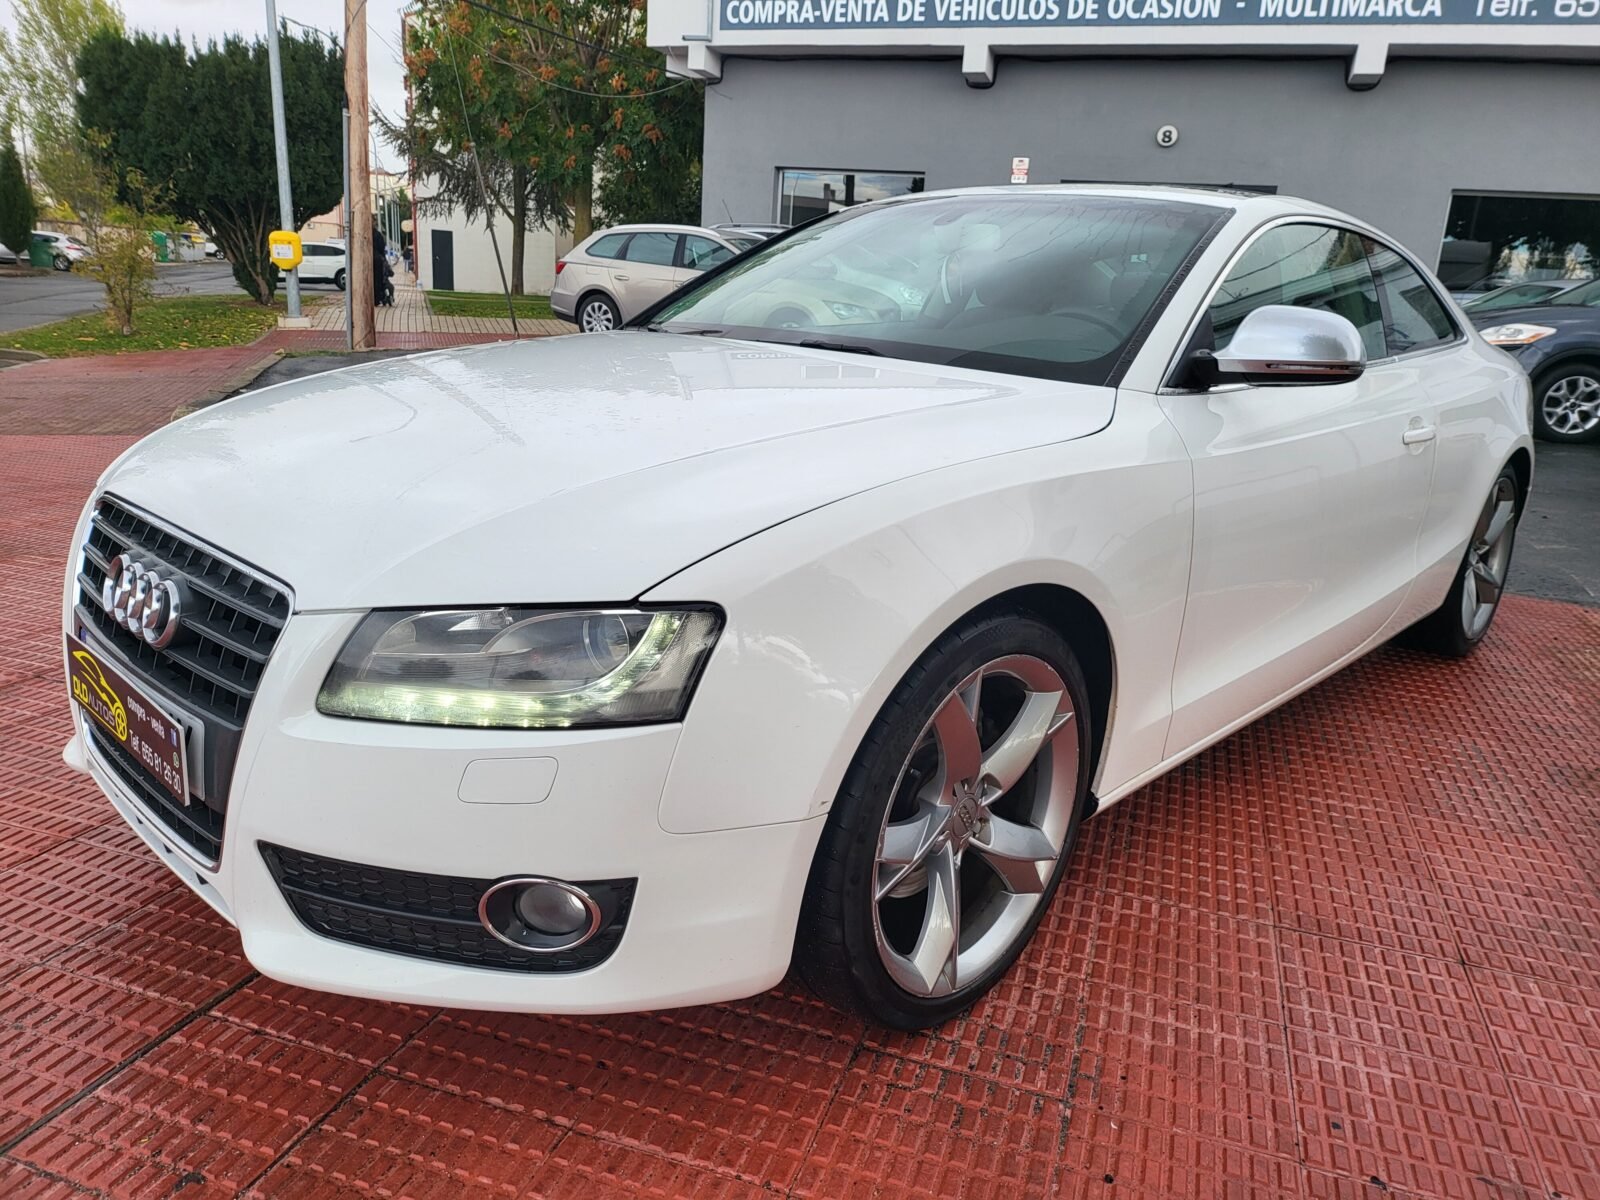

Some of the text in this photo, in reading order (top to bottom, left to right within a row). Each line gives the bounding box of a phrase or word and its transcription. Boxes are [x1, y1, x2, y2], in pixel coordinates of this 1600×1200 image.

[726, 0, 889, 24] COMPRA-VENTA
[897, 0, 926, 22] DE
[1067, 0, 1099, 20] DE
[1259, 0, 1443, 18] MULTIMARCA
[1161, 130, 1173, 144] 8
[127, 696, 146, 722] compra
[151, 716, 165, 740] venta
[154, 753, 162, 775] 81
